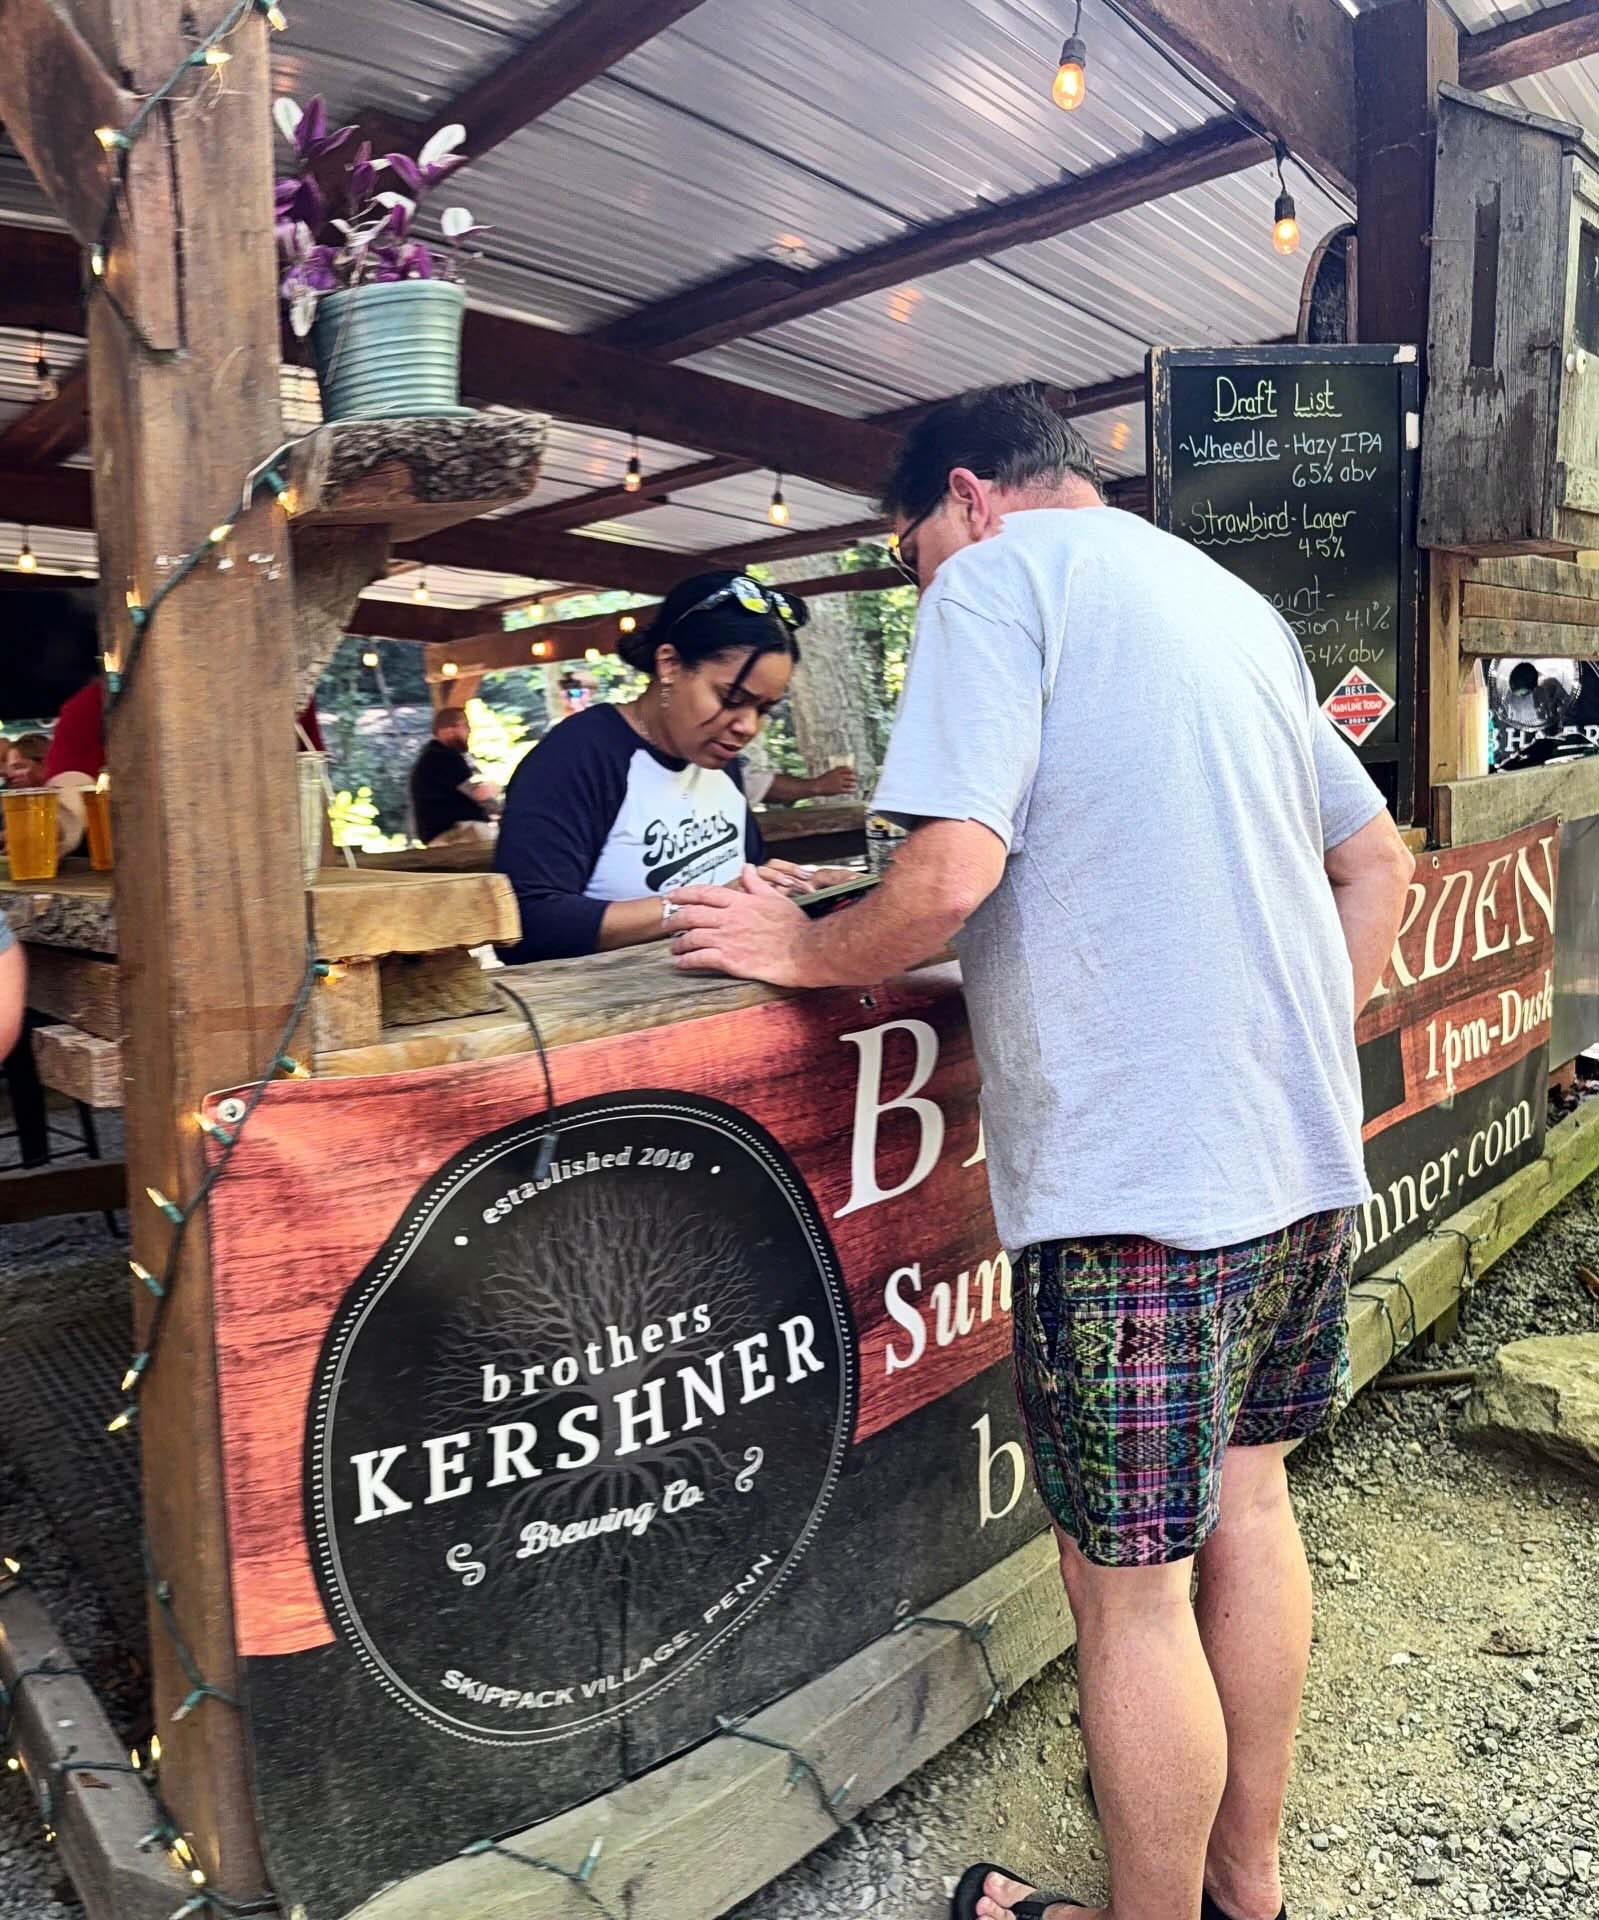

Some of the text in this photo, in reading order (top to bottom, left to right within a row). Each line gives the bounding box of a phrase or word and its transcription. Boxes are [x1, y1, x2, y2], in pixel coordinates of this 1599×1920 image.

[1214, 377, 1336, 417] Draft List
[1340, 431, 1383, 453] IPA
[1339, 458, 1377, 482] abv
[1303, 503, 1357, 540] Lager
[1344, 601, 1392, 631] 4.1%
[1348, 639, 1385, 664] abv
[1345, 685, 1368, 696] BEST
[637, 1147, 695, 1172] 2018
[480, 1302, 713, 1403] brothers
[349, 1314, 826, 1524] KERSHNER
[515, 1502, 657, 1559] Brewing
[441, 1669, 575, 1709] SKIPPACK
